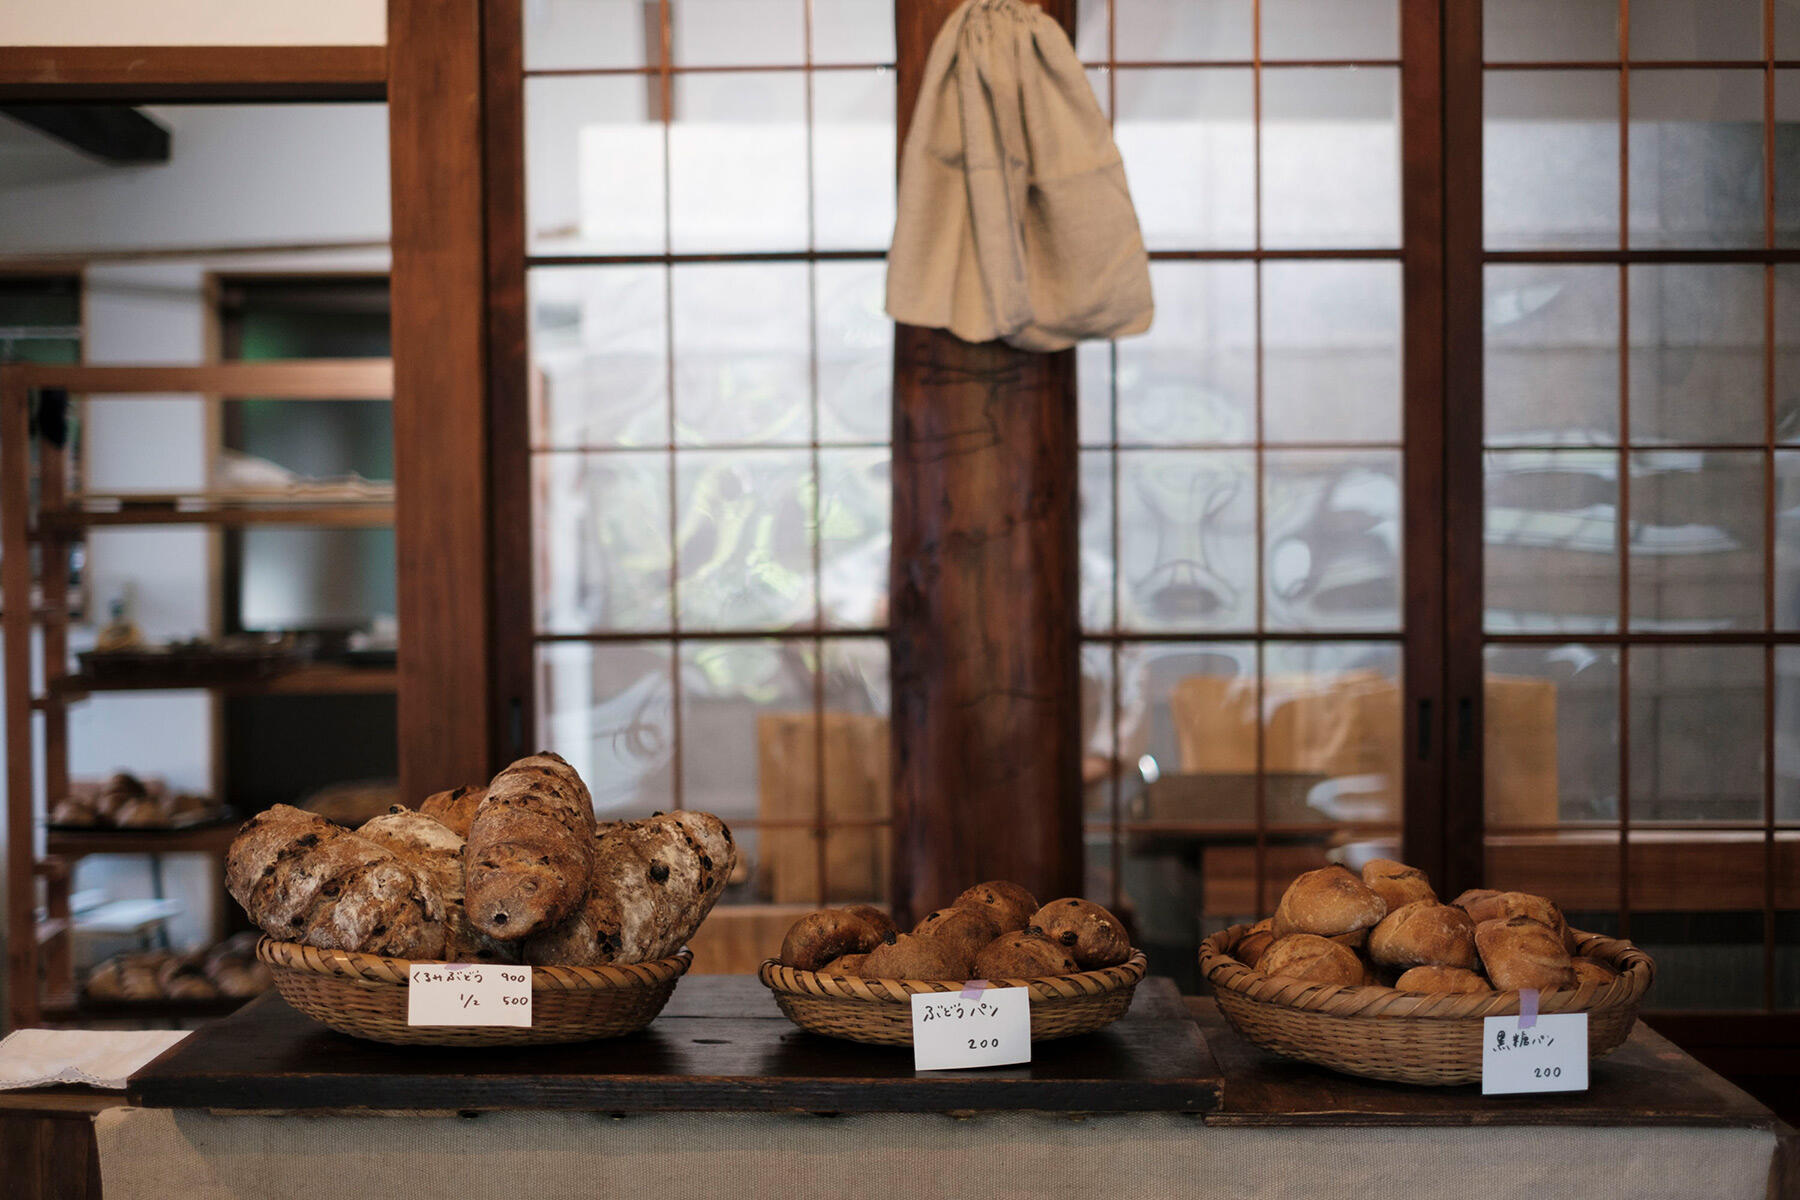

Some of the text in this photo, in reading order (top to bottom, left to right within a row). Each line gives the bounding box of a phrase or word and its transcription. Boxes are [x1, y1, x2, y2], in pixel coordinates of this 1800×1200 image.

[413, 970, 525, 983] くるみぶどう 900
[460, 993, 528, 1009] 1/2 500
[923, 1003, 998, 1022] ぶどうパン
[968, 1038, 999, 1050] 200
[1493, 1030, 1554, 1052] 黒糖パン
[1534, 1066, 1562, 1078] 200
